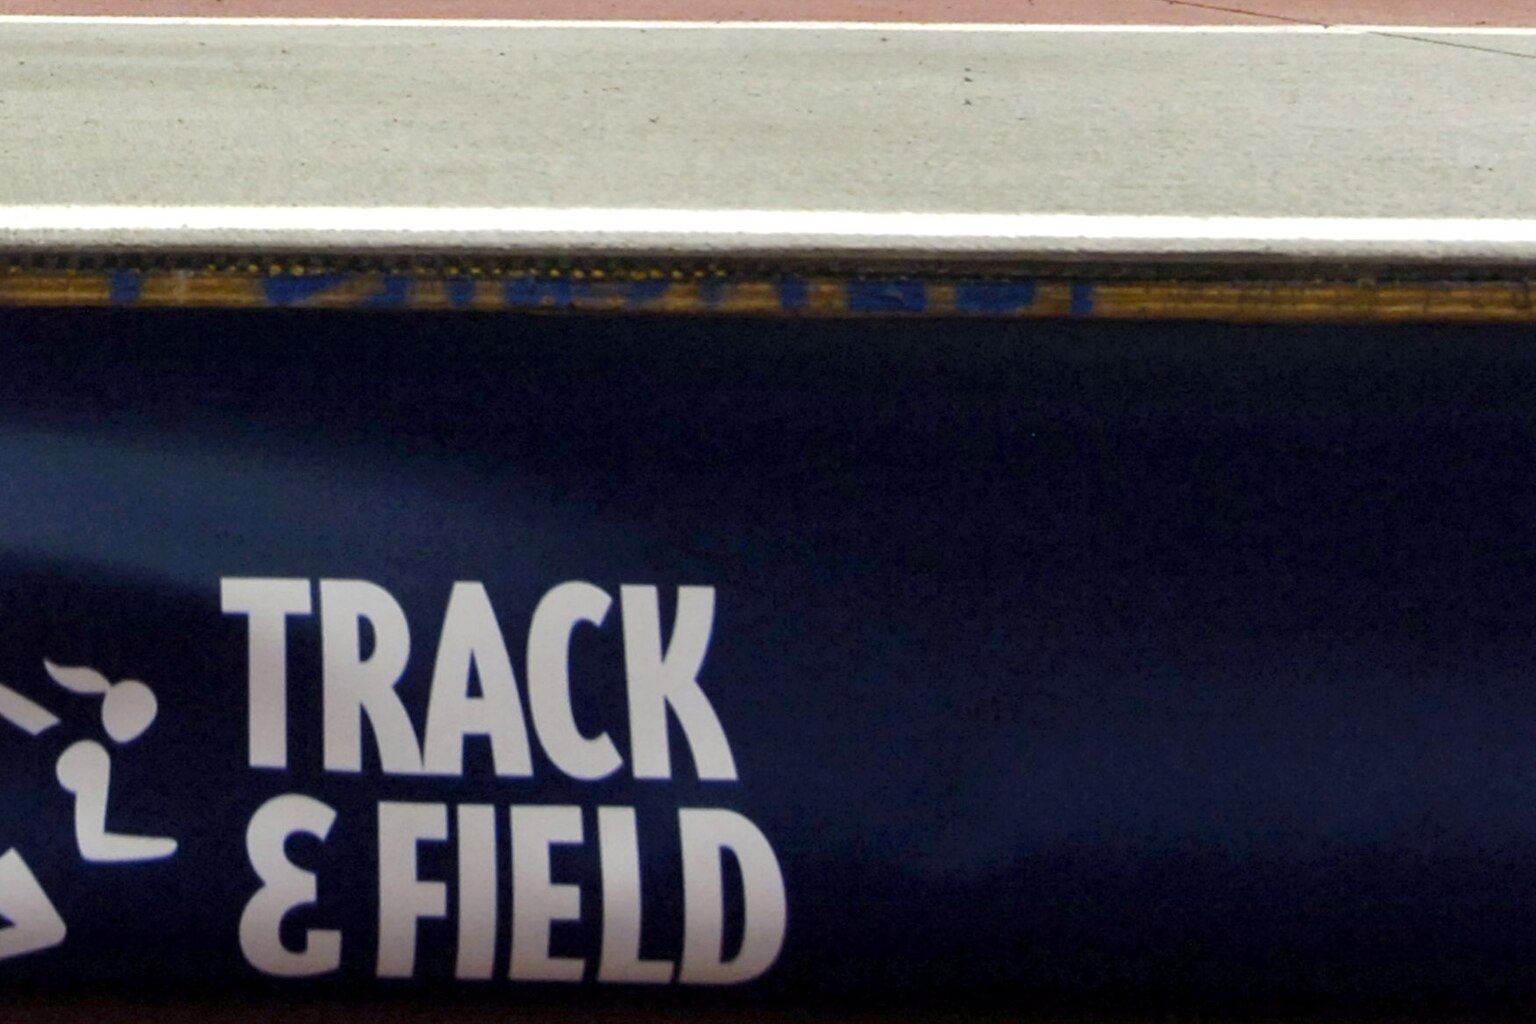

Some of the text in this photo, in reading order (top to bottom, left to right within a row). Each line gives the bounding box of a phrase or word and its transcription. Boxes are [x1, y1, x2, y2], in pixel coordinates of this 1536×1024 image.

[220, 577, 739, 784] TRACK
[239, 794, 789, 986] & FIELD
